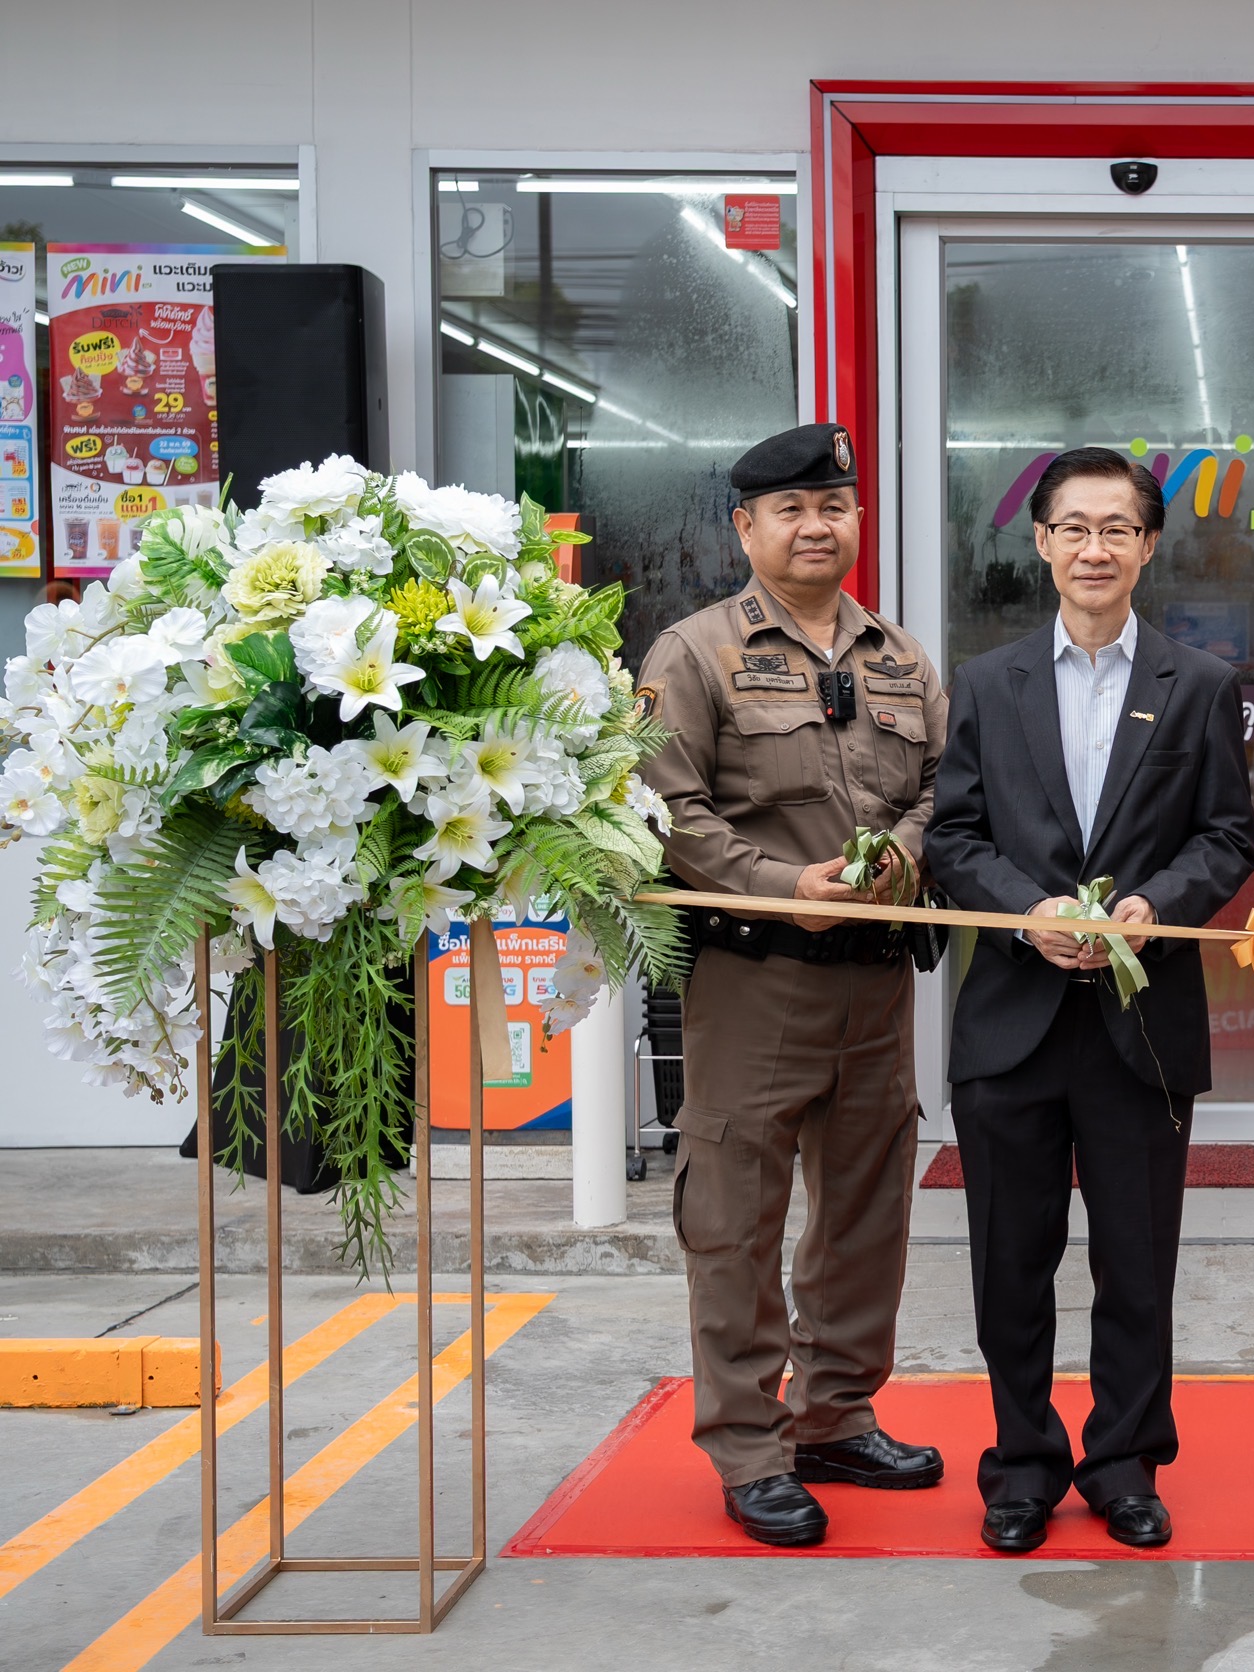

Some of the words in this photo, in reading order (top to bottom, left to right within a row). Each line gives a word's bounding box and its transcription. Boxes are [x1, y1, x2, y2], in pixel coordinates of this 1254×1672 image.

[62, 258, 88, 274] NEW
[153, 263, 213, 276] แวะเต็ม
[61, 264, 143, 300] mini
[176, 281, 213, 293] แวะม
[153, 392, 184, 413] 29
[137, 494, 143, 502] 1
